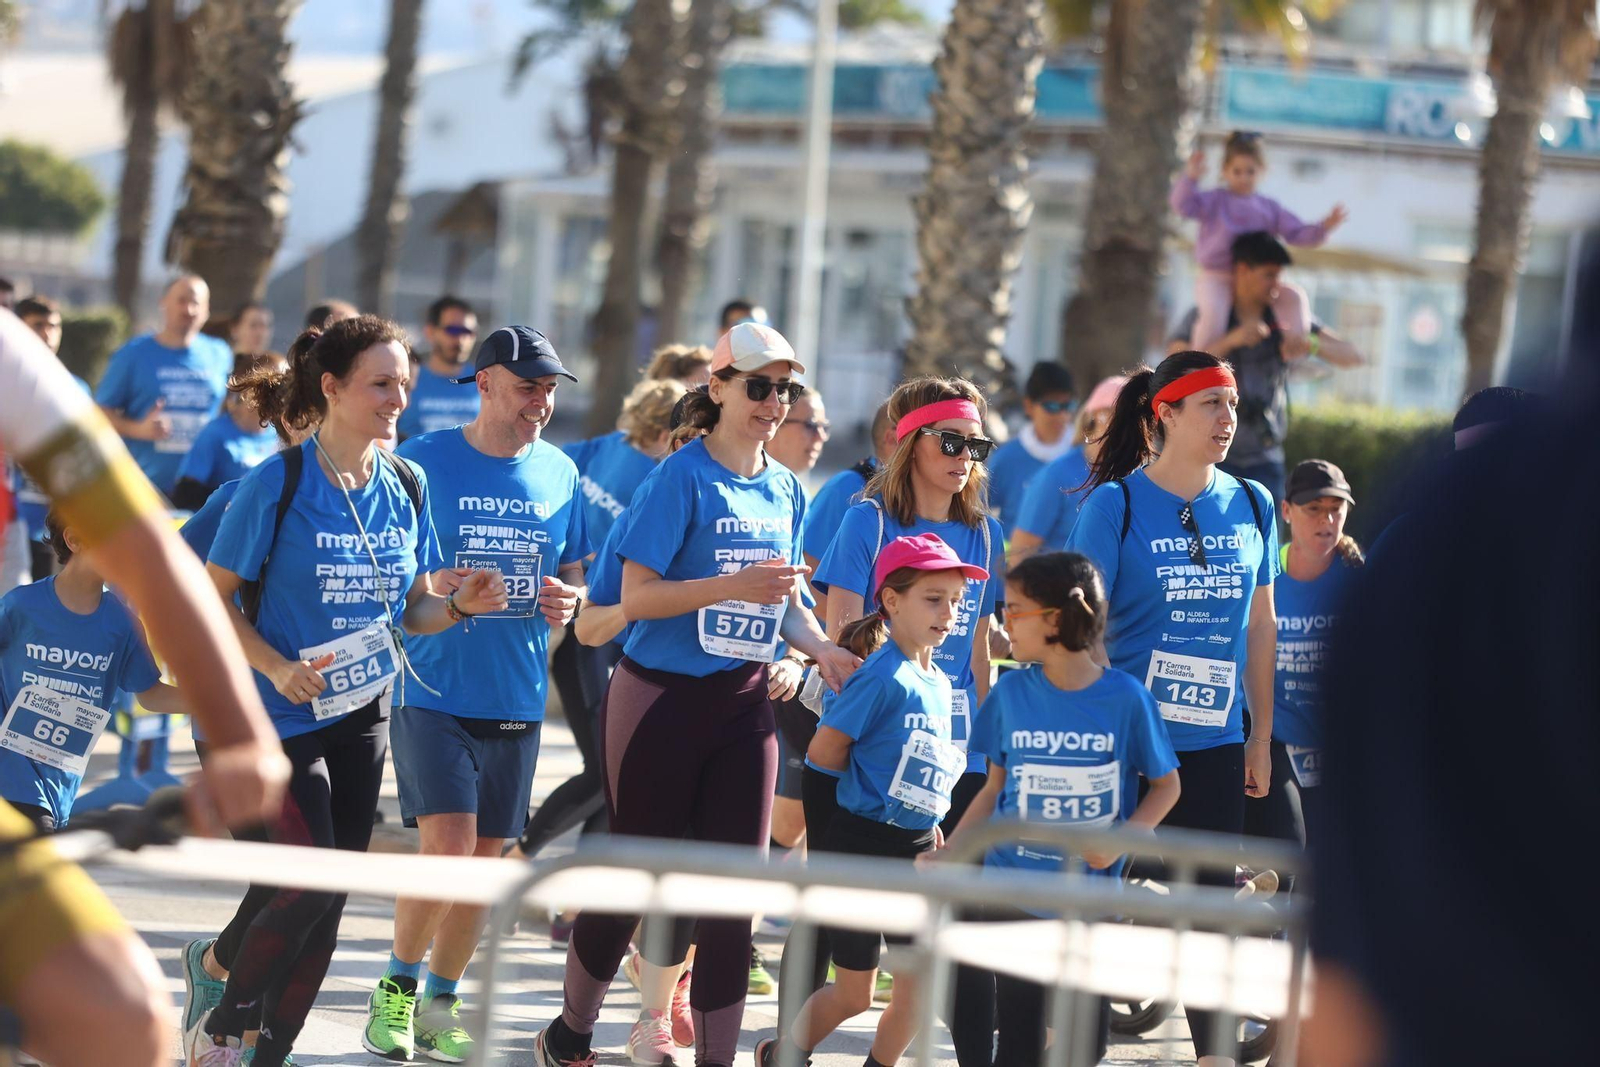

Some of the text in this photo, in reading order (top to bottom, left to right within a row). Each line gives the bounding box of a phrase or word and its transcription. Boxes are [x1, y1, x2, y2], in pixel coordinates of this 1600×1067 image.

[459, 496, 550, 517] mayoral
[316, 529, 408, 553] mayoral
[459, 525, 547, 543] RUNNING
[468, 538, 539, 553] MAKES
[316, 563, 410, 577] RUNNING
[1156, 562, 1246, 578] RUNNING
[326, 578, 400, 590] MAKES
[1168, 575, 1242, 590] MAKES
[322, 591, 399, 604] FRIENDS
[1166, 588, 1243, 602] FRIENDS
[716, 614, 766, 640] 570
[26, 643, 114, 671] mayoral
[1165, 668, 1194, 679] Solidaria
[1166, 661, 1191, 671] Carrera
[1208, 664, 1232, 674] mayoral
[330, 656, 381, 692] 664
[22, 671, 103, 699] RUNNING
[33, 692, 60, 709] Carrera
[319, 698, 334, 707] 5KM
[1166, 683, 1216, 707] 143
[30, 700, 61, 717] Solidaria
[76, 706, 104, 721] mayoral
[33, 719, 70, 747] 66
[500, 722, 526, 730] adidas
[5, 731, 19, 740] 5KM
[1012, 730, 1114, 755] mayoral
[899, 782, 912, 790] 5KM
[1038, 775, 1067, 785] Carrera
[1038, 783, 1073, 791] Solidaria
[1042, 797, 1101, 819] 813
